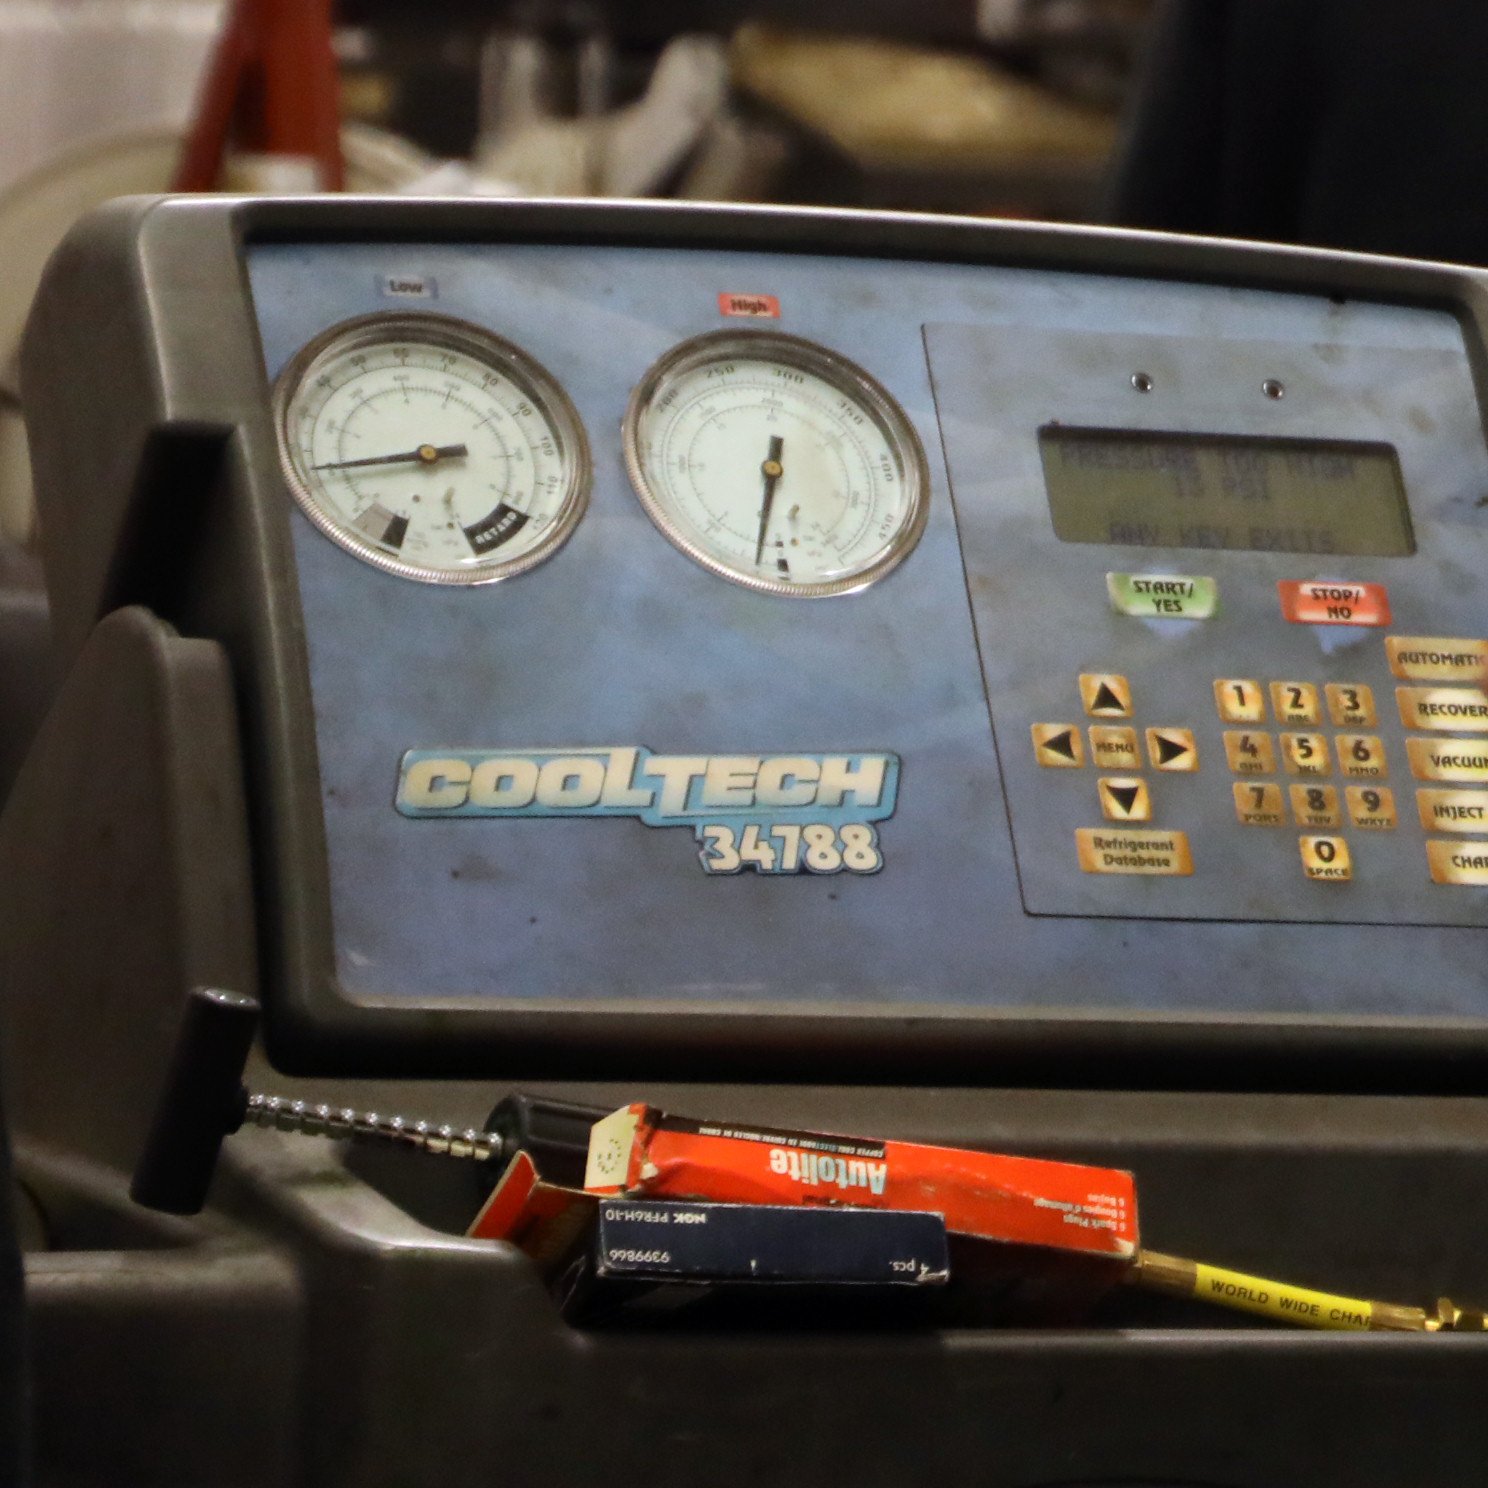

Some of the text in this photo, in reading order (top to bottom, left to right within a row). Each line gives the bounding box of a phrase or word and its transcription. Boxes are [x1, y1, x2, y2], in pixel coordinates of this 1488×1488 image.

[389, 278, 423, 294] Low
[730, 298, 768, 315] High
[483, 373, 499, 388] 80
[704, 364, 736, 380] 250
[772, 367, 806, 385] 300
[517, 401, 532, 417] 90
[836, 401, 865, 427] 350
[539, 434, 556, 458] 100
[878, 453, 896, 483] 400
[877, 513, 896, 540] 450
[1133, 579, 1194, 598] START/
[1311, 587, 1360, 604] STOP/
[1152, 599, 1183, 613] YES
[1326, 606, 1352, 619] NO
[1233, 685, 1246, 707] 1
[1287, 687, 1304, 709] 2
[1343, 689, 1360, 711] 3
[1095, 742, 1135, 754] MENU
[1239, 735, 1258, 758] 4
[1297, 737, 1314, 759] 5
[1352, 739, 1371, 762] 6
[1249, 787, 1265, 810] 7
[1306, 788, 1327, 811] 8
[1361, 790, 1381, 812] 9
[1433, 805, 1484, 821] INJECT
[703, 823, 880, 871] 34788
[1093, 836, 1175, 853] Refrigerant
[1314, 840, 1336, 863] 0
[1103, 853, 1171, 868] Database
[1306, 866, 1348, 877] SPACE
[769, 1147, 888, 1196] Autolite
[673, 1211, 707, 1224] NGK
[608, 1249, 670, 1264] 9399866
[889, 1259, 915, 1273] pcs.
[1210, 1278, 1270, 1305] WORLD
[1279, 1295, 1321, 1317] WIDE
